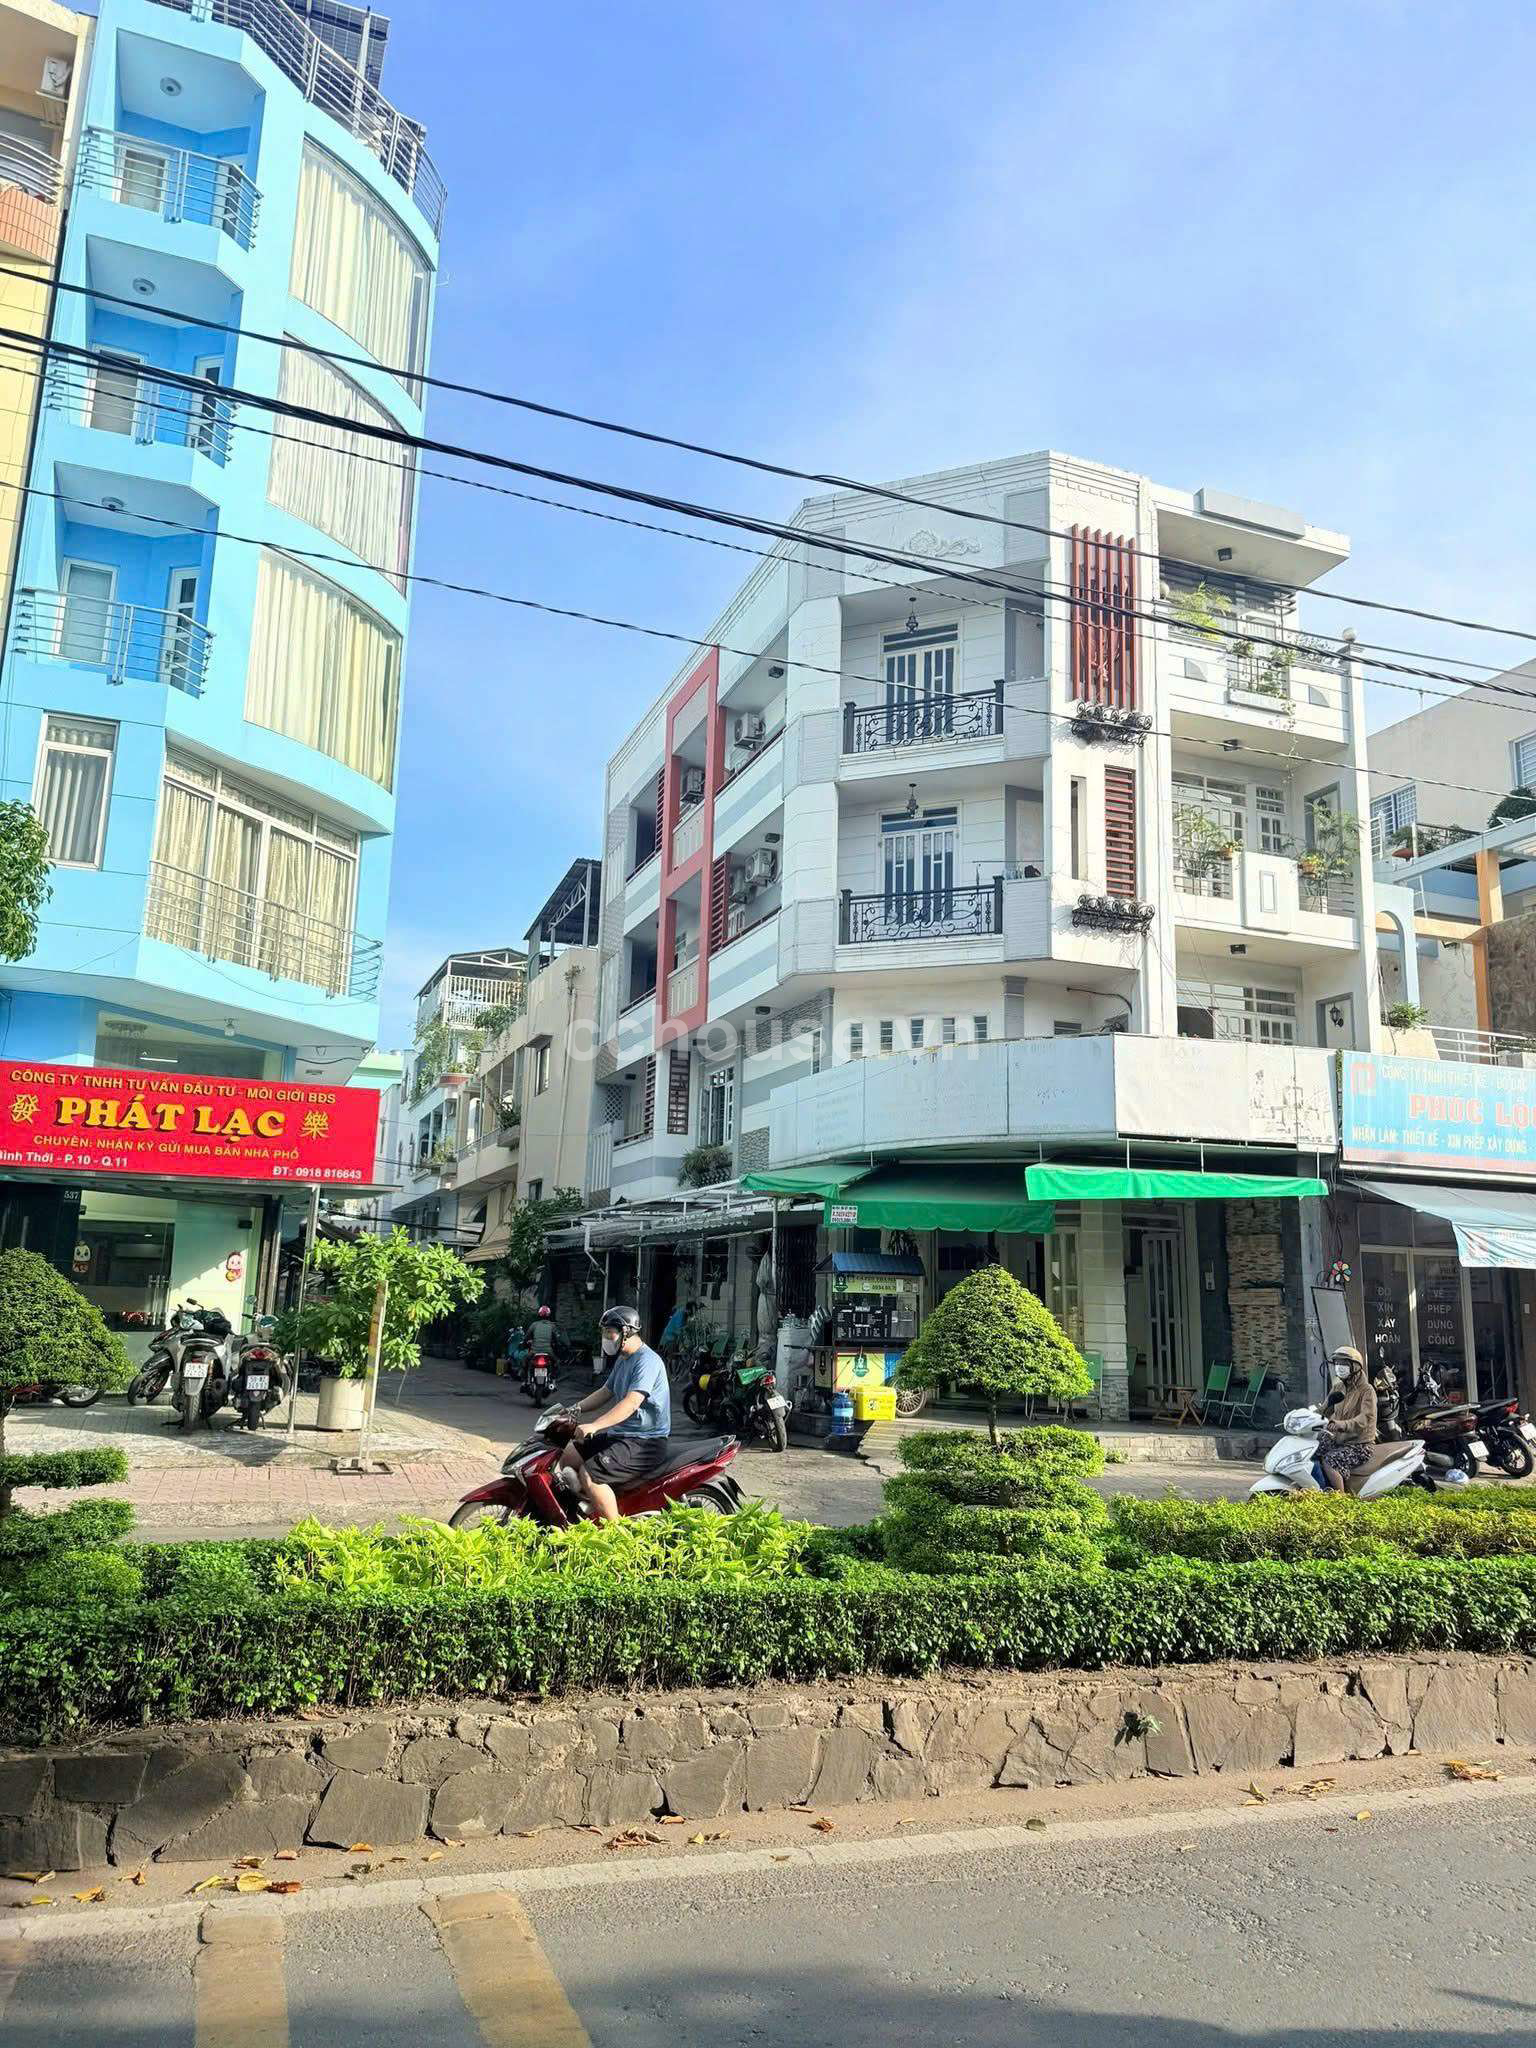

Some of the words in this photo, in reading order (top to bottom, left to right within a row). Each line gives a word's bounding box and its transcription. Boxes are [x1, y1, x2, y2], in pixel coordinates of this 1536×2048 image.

[11, 1068, 55, 1084] CÔNG
[59, 1073, 79, 1085] TY
[83, 1075, 123, 1089] TNHH
[308, 1092, 336, 1104] BĐS
[55, 1094, 186, 1131] PHÁT
[193, 1106, 285, 1143] LẠC
[33, 1135, 92, 1148] CHUYÊN:
[184, 1144, 211, 1155] MUA
[215, 1144, 241, 1156] BÁN
[272, 1166, 293, 1176] ĐT:
[296, 1167, 321, 1178] 0918
